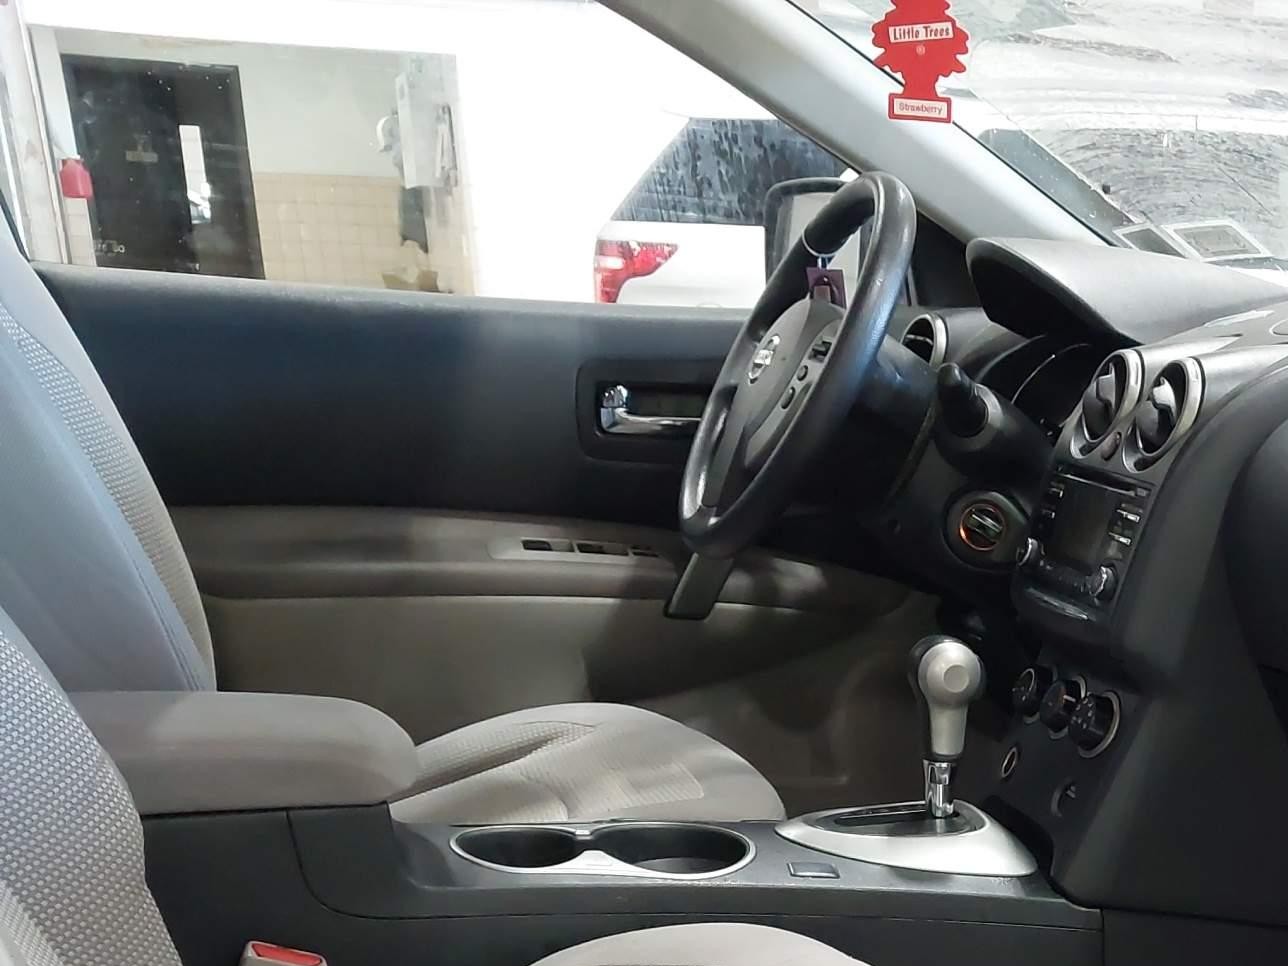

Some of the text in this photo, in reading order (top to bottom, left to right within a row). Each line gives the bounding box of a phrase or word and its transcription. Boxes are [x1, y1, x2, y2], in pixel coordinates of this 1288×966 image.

[893, 25, 950, 41] Little Trees
[898, 102, 943, 115] Strawberry
